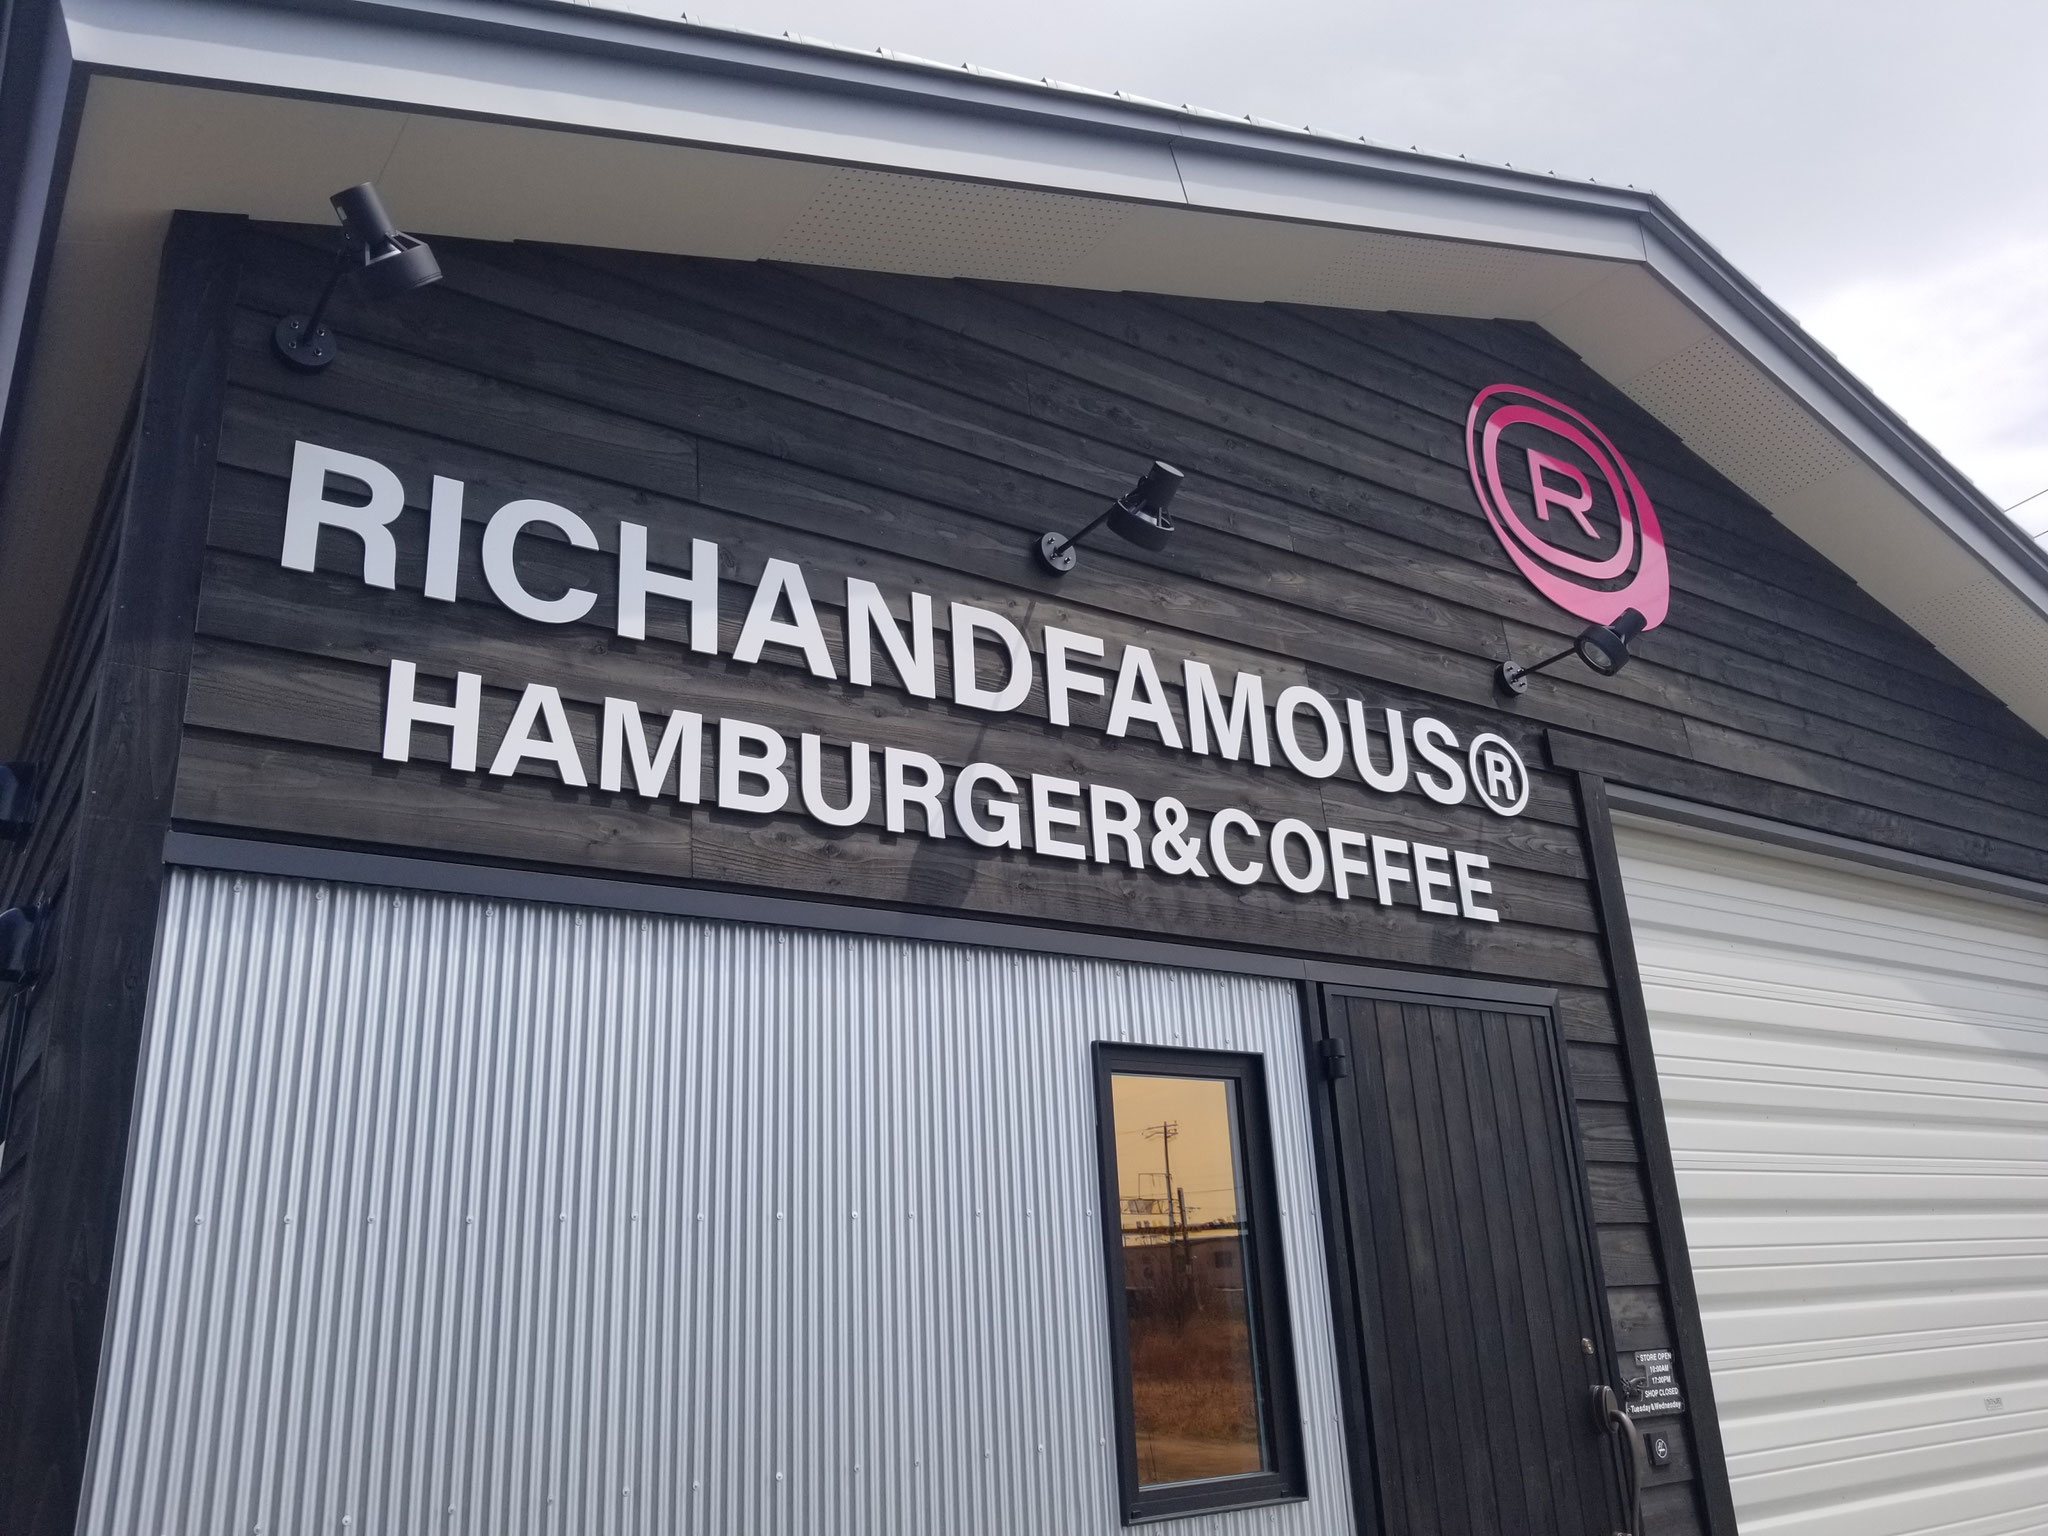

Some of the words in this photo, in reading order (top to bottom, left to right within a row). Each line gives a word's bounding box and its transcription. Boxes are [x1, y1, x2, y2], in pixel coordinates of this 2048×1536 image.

[382, 659, 1500, 922] HAMBURGER&COFFEE
[1640, 1353, 1657, 1362] STORE
[1657, 1352, 1672, 1360] OPEN
[1644, 1389, 1659, 1398] SHOP
[1659, 1387, 1679, 1396] CLOSED
